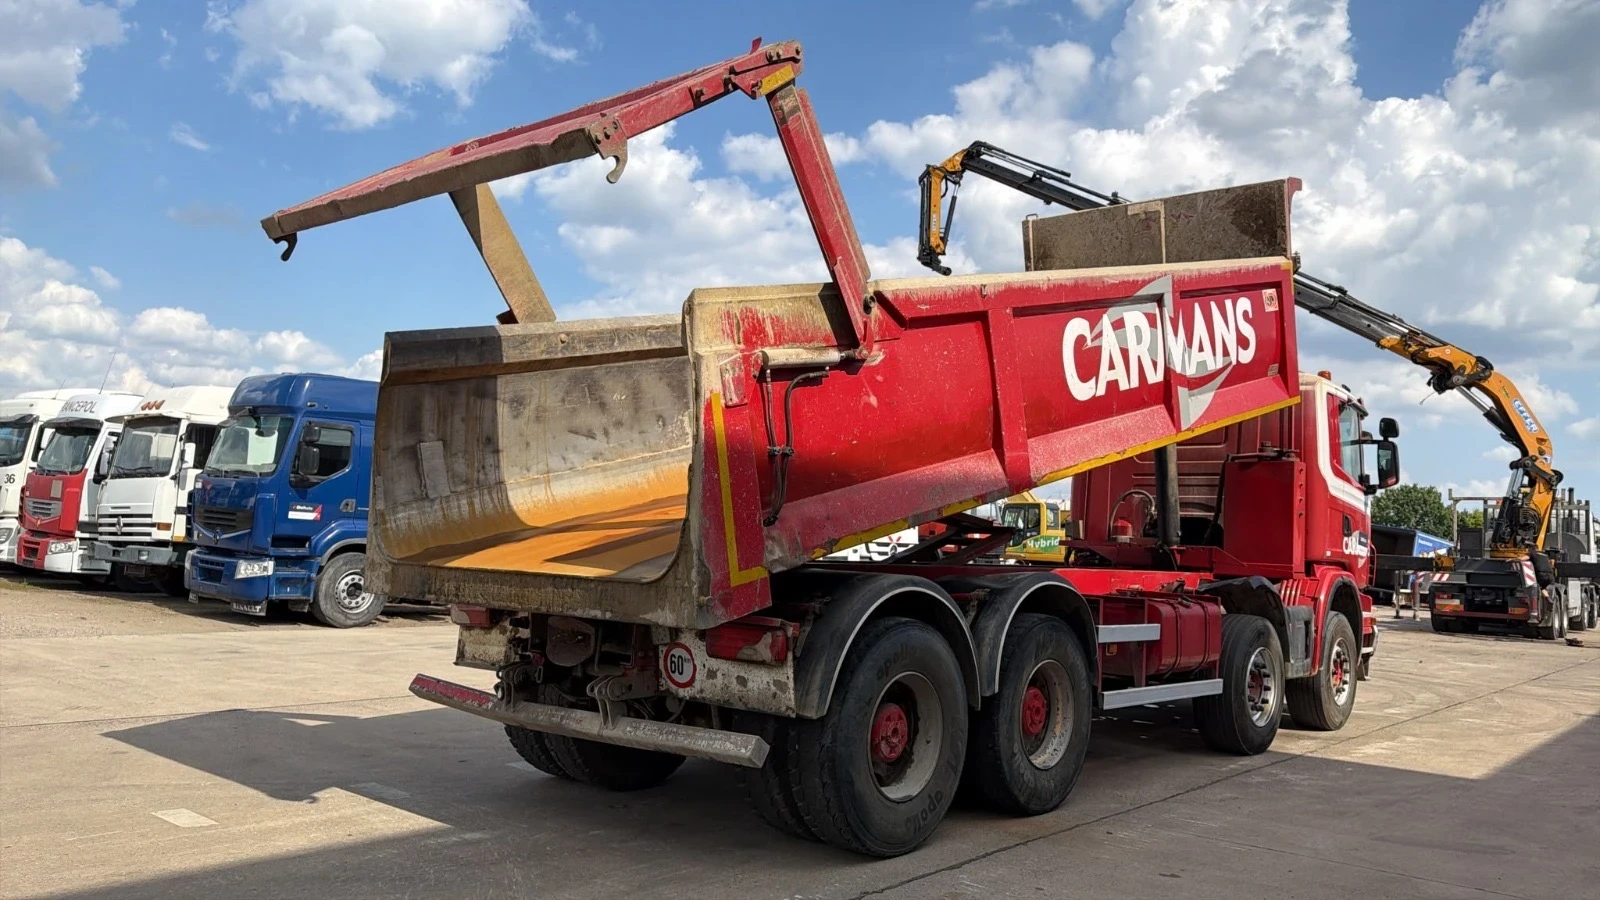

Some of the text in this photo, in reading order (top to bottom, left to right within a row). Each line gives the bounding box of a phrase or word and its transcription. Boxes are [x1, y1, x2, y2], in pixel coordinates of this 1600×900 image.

[1062, 296, 1257, 401] CARMANS
[4, 473, 16, 484] 36
[1027, 536, 1060, 549] Hybrid
[670, 653, 684, 676] 60
